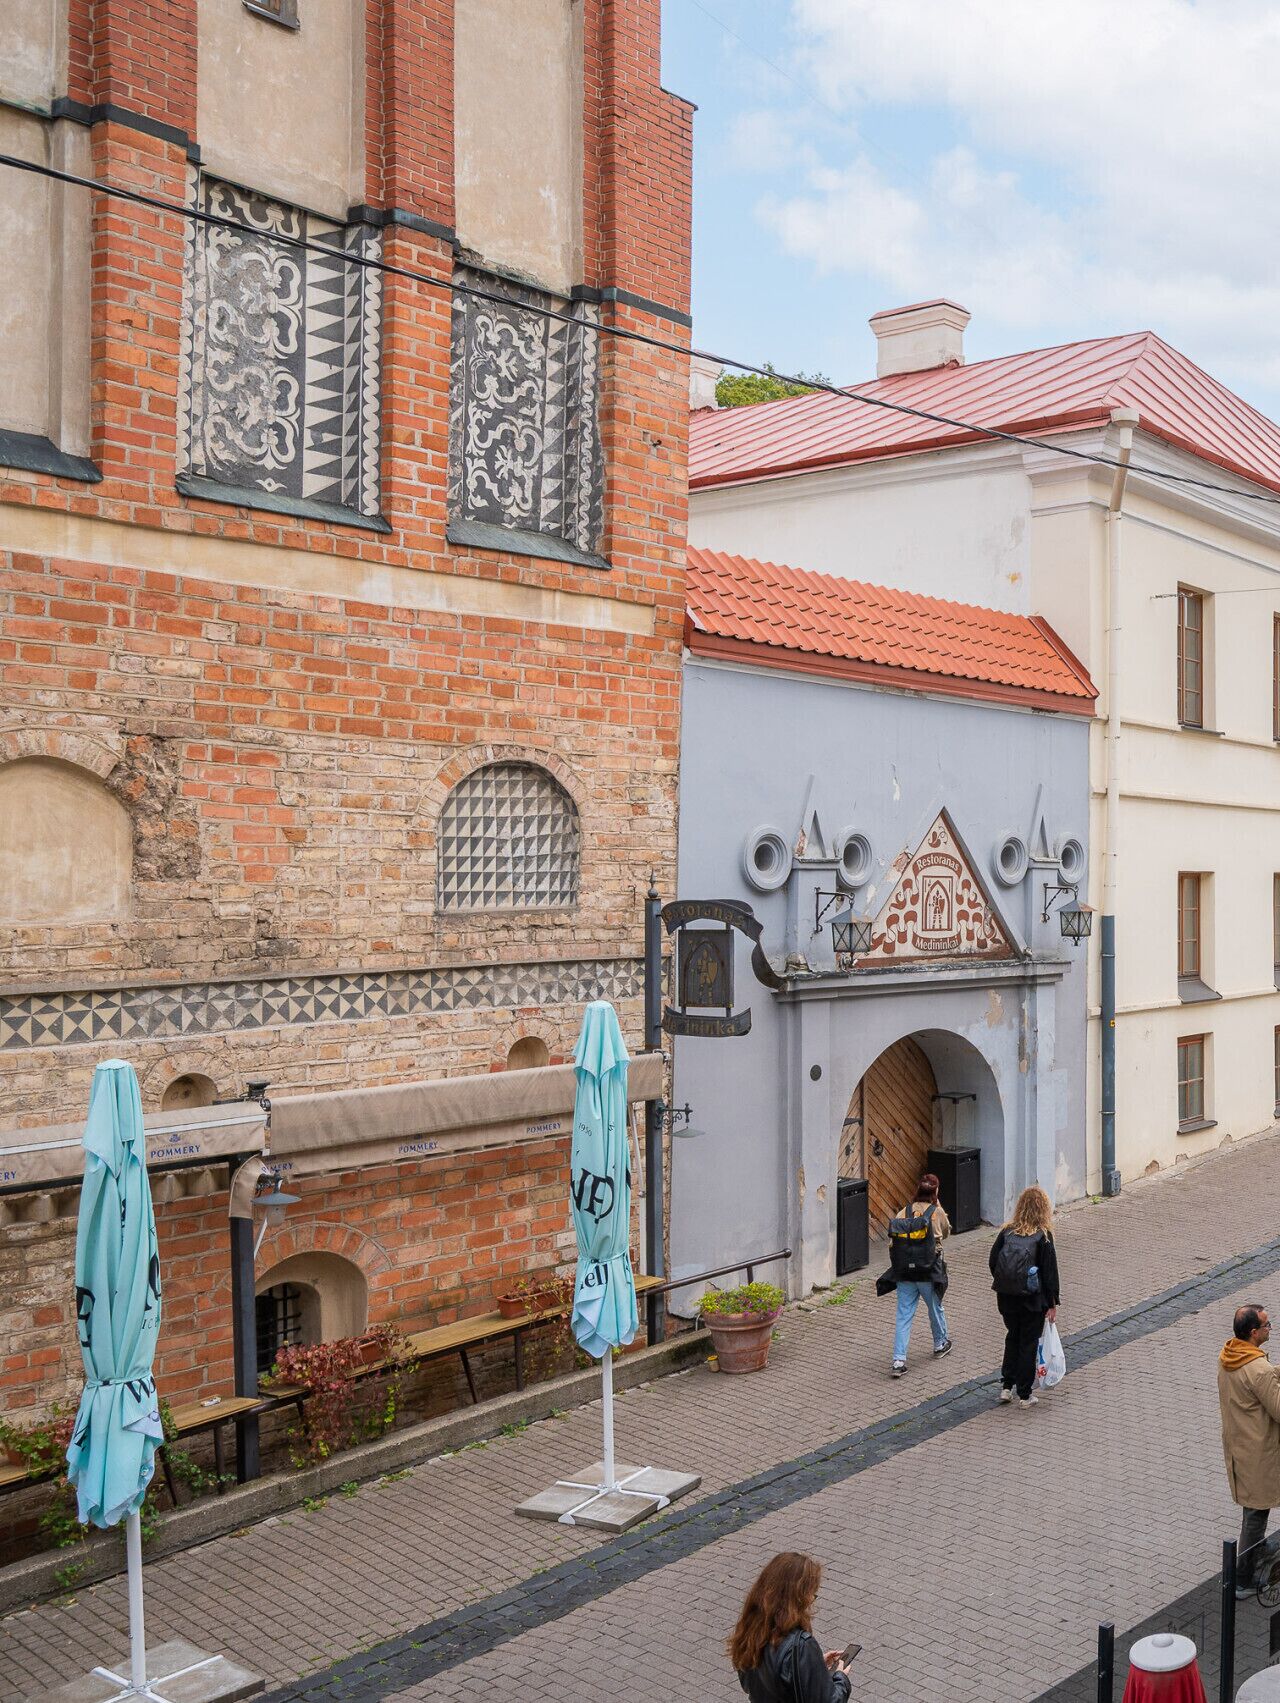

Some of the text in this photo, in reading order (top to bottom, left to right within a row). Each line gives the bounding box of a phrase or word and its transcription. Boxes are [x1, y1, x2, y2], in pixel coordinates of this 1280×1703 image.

[916, 854, 959, 871] Restoranas
[915, 936, 959, 950] Medininkai
[526, 1122, 562, 1134] POMMERY
[150, 1144, 201, 1159] POMMERY
[398, 1141, 439, 1154] POMMERY
